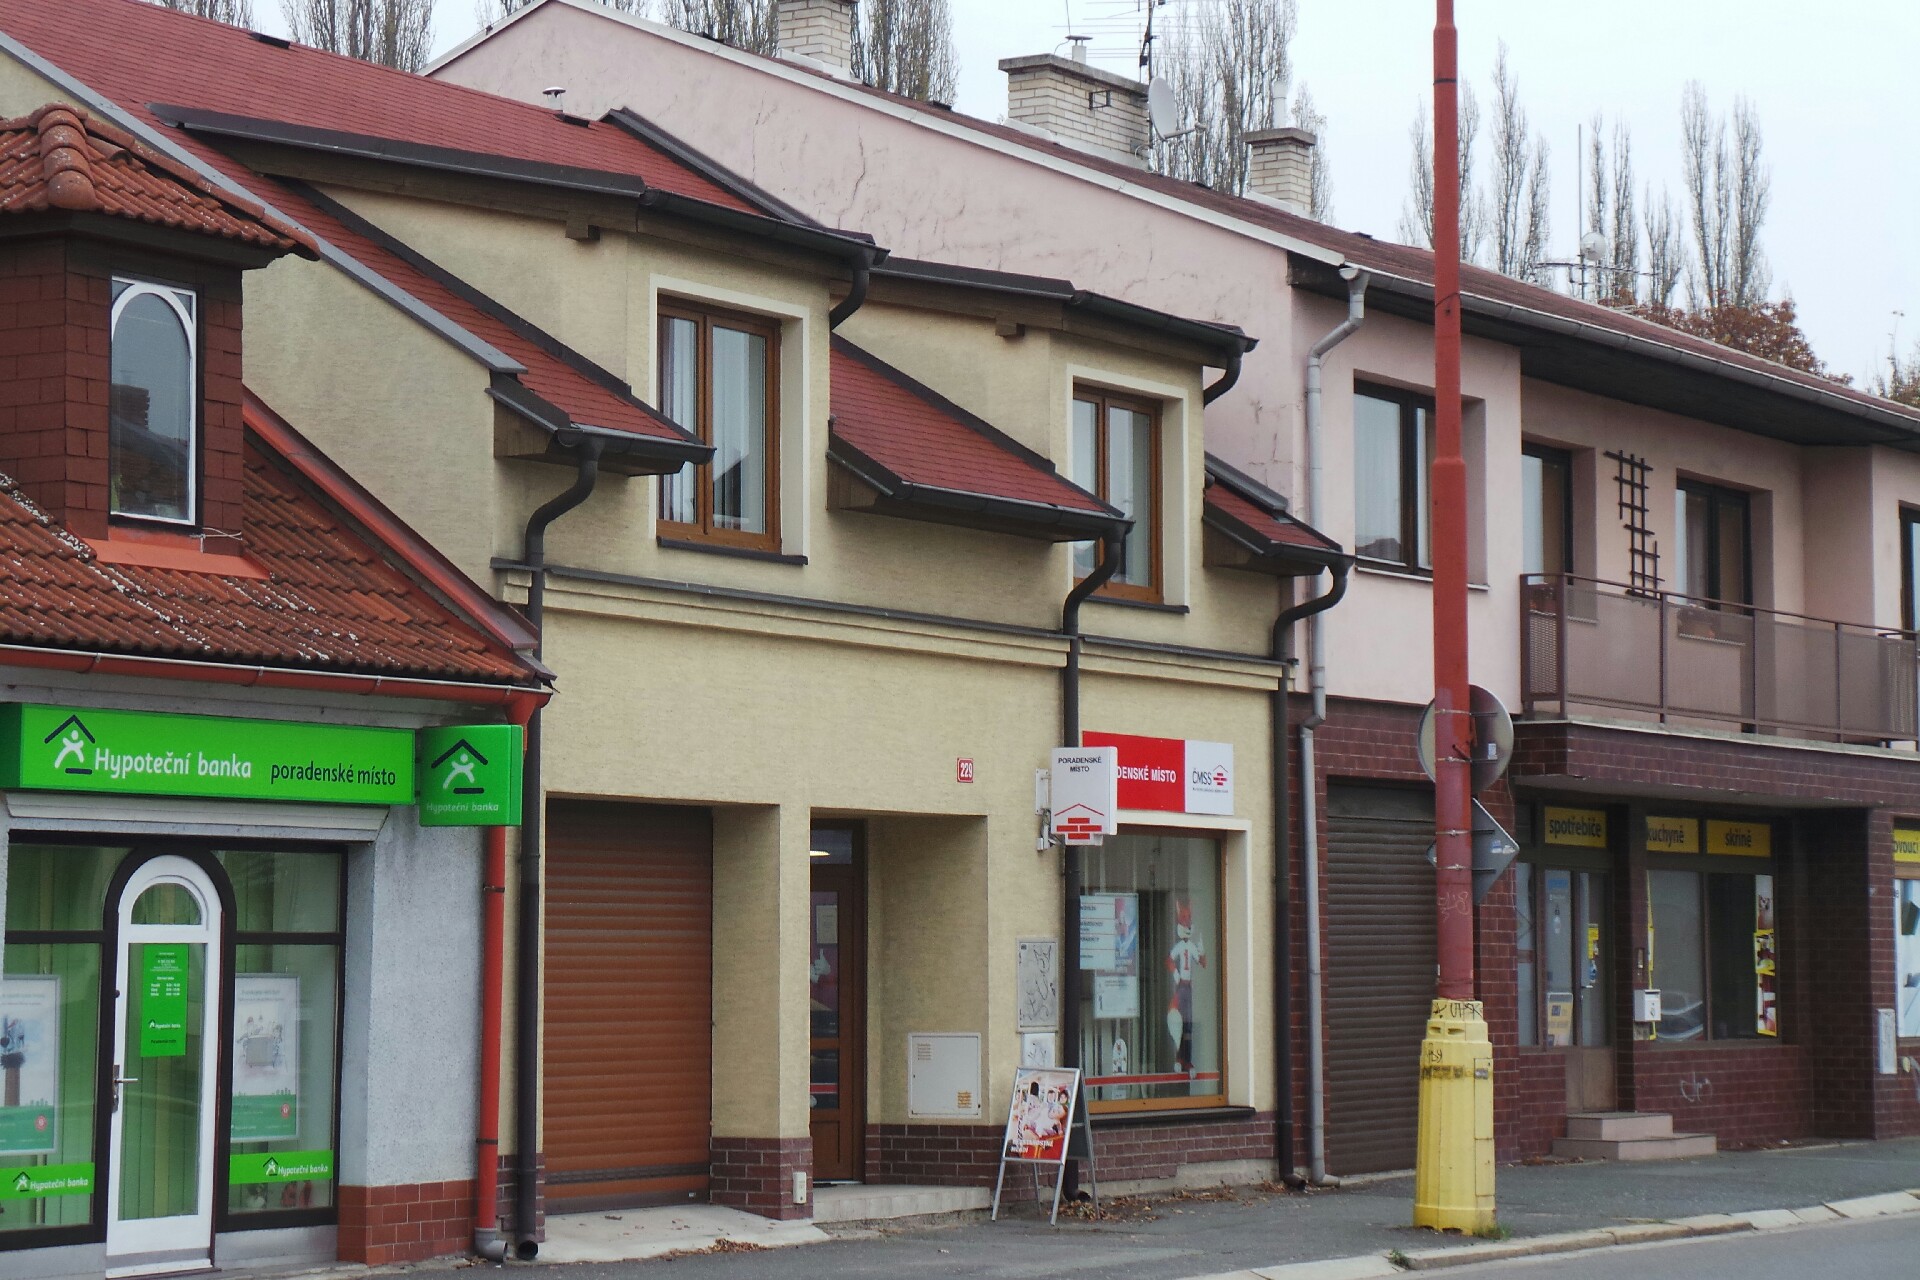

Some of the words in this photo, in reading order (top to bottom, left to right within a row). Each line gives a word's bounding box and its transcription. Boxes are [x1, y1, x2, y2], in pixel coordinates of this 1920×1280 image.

[94, 747, 191, 780] Hypoteční
[198, 751, 252, 779] banka
[271, 760, 354, 784] poradenské
[357, 765, 396, 786] místo
[1058, 756, 1102, 764] PORADENSKÉ
[960, 762, 973, 778] 229
[1151, 766, 1177, 783] MÍSTO
[1192, 767, 1213, 786] ČMSS
[426, 802, 469, 814] Hypoteční
[472, 802, 499, 812] banka
[1549, 815, 1601, 839] spotřebiče
[278, 1164, 309, 1177] Hypoteční
[309, 1163, 329, 1174] banka
[30, 1179, 65, 1192] Hypoteční
[67, 1177, 89, 1188] banka
